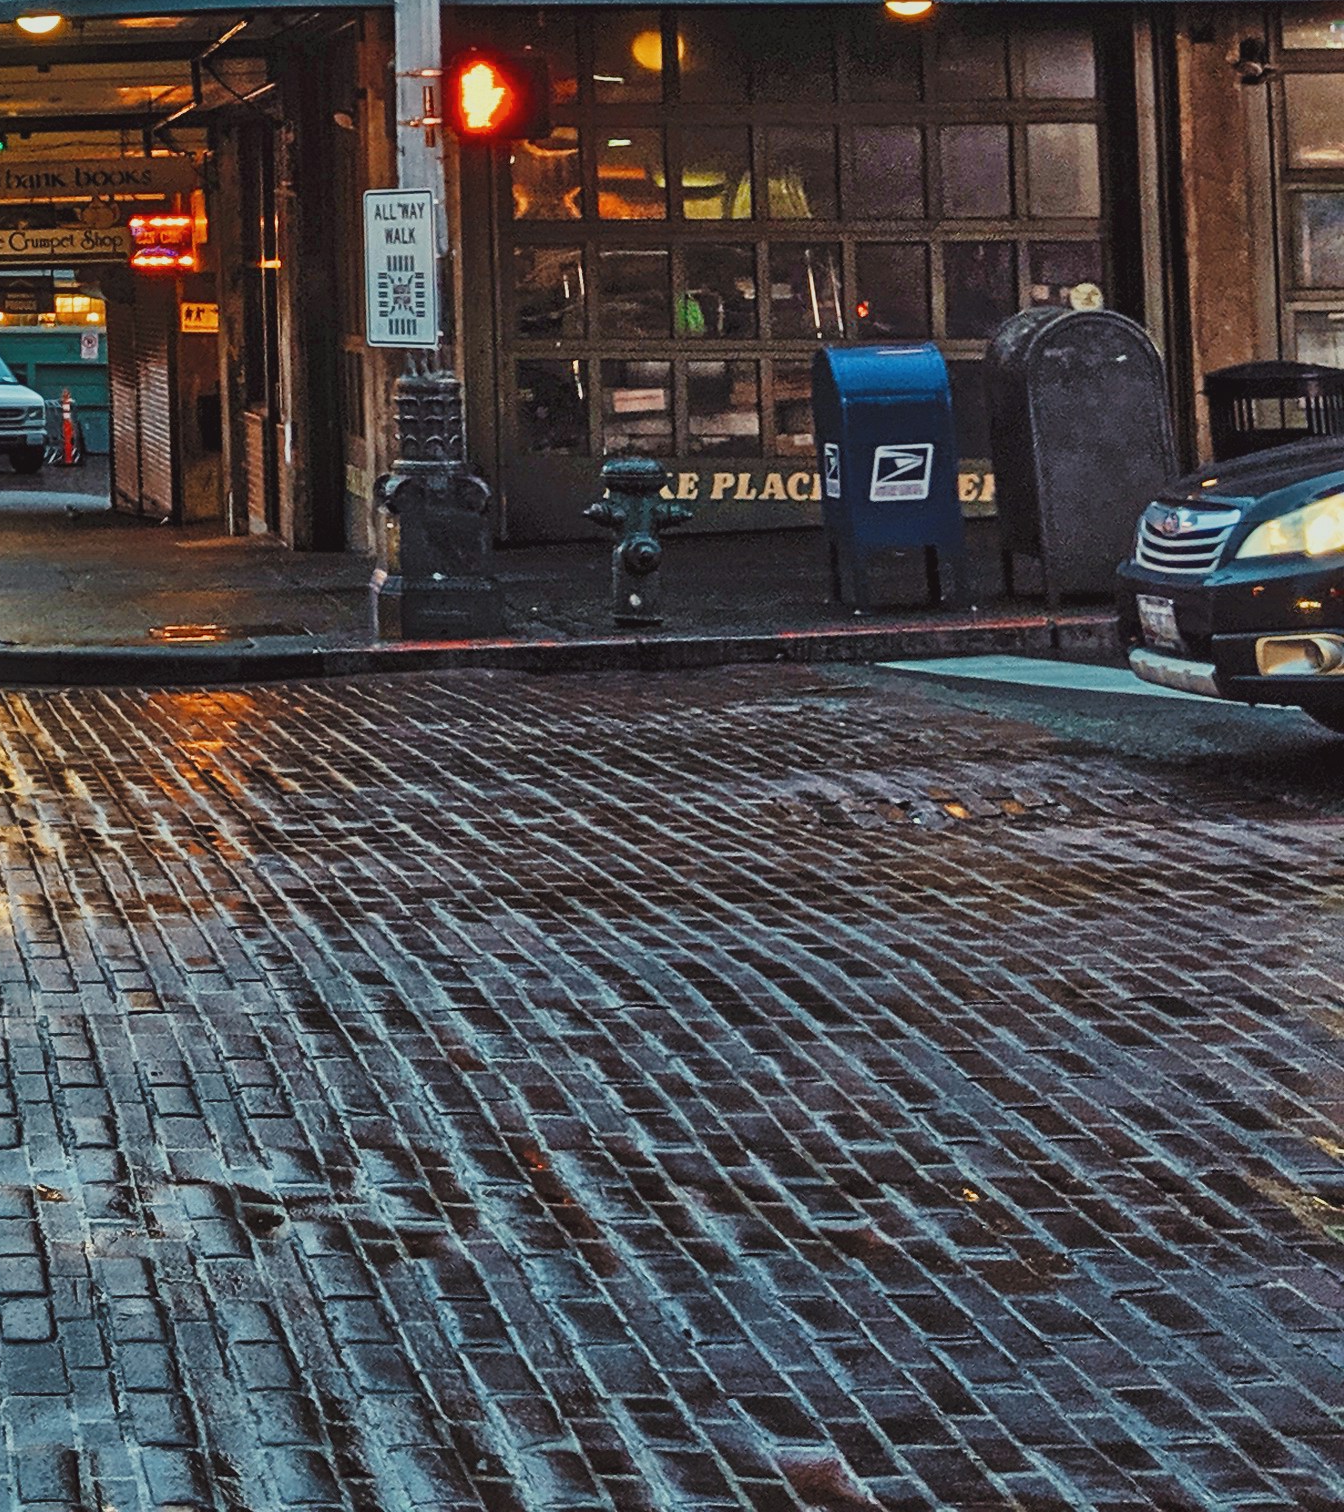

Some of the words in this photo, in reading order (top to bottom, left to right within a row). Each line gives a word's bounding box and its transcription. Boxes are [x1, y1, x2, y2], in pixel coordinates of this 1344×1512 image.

[75, 167, 152, 187] books
[375, 204, 396, 221] ALL
[398, 202, 425, 219] WAY
[9, 232, 75, 253] Crumpet
[81, 230, 124, 252] Shop
[384, 227, 416, 244] WALK
